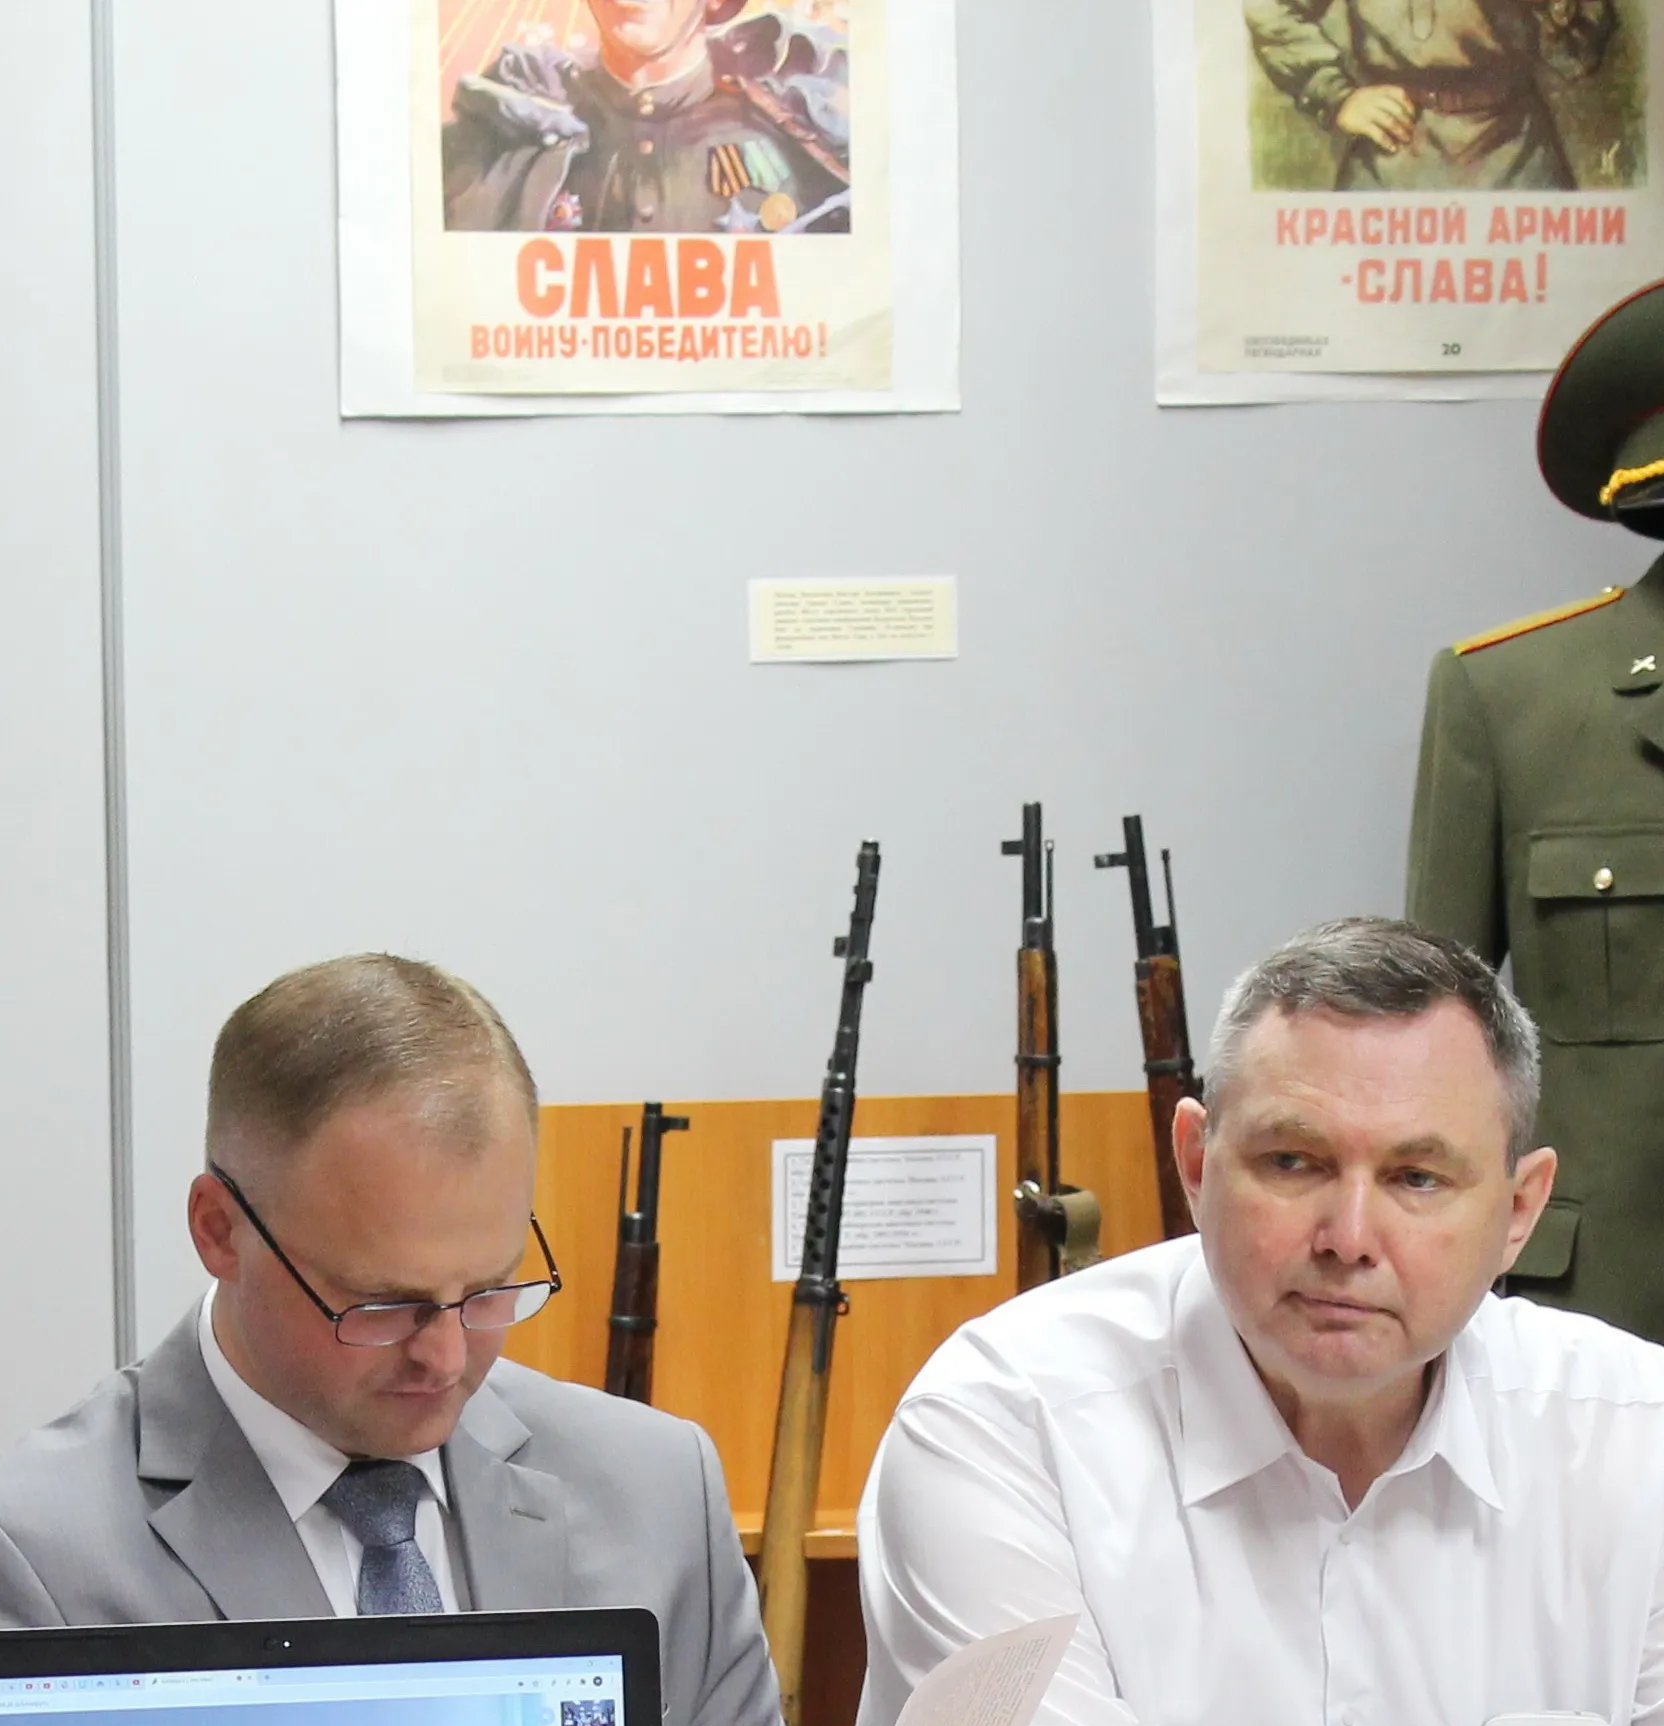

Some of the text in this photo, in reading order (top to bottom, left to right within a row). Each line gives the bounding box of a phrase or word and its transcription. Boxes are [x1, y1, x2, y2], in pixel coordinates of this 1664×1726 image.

[1275, 202, 1627, 246] КРАСНОЙ АРМИИ
[516, 237, 782, 319] СЛАВА
[1442, 342, 1462, 356] 20
